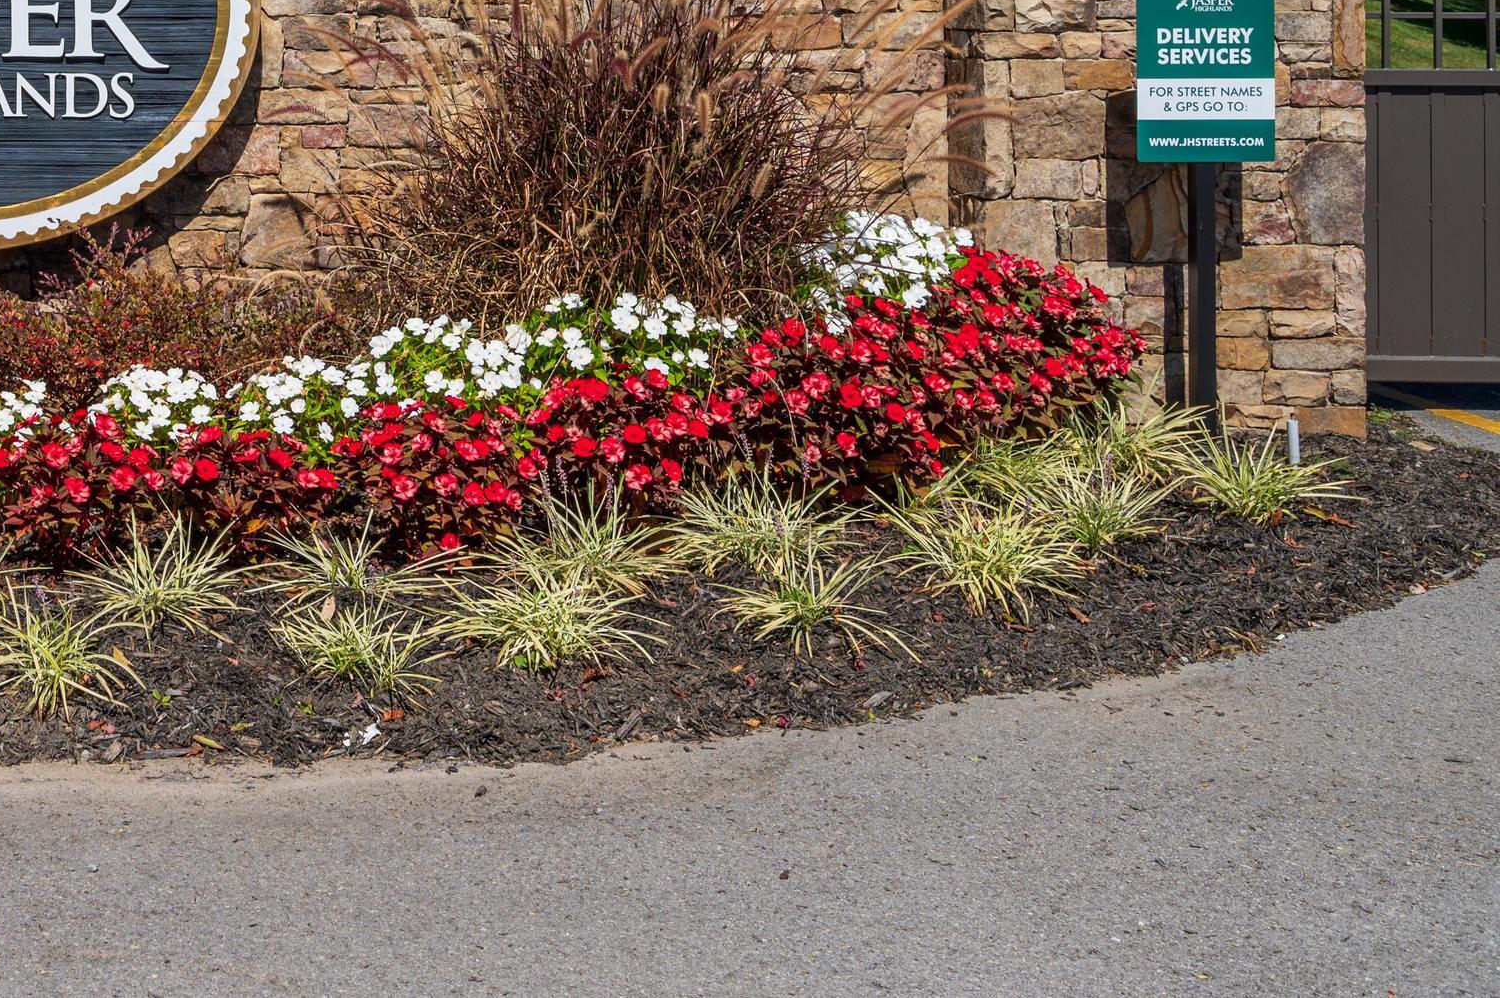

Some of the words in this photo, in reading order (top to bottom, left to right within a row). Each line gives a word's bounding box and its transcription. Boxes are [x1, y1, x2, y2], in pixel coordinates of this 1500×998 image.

[1156, 27, 1254, 44] DELIVERY
[1157, 48, 1252, 65] SERVICES
[1149, 87, 1173, 97] FOR
[1177, 87, 1216, 97] STREET
[1220, 87, 1263, 97] NAMES
[1163, 102, 1172, 112] &
[1176, 102, 1199, 112] GPS
[1203, 102, 1223, 112] GO
[1227, 102, 1248, 112] TO:
[1149, 137, 1264, 147] WWW.JHSTREETS.COM
